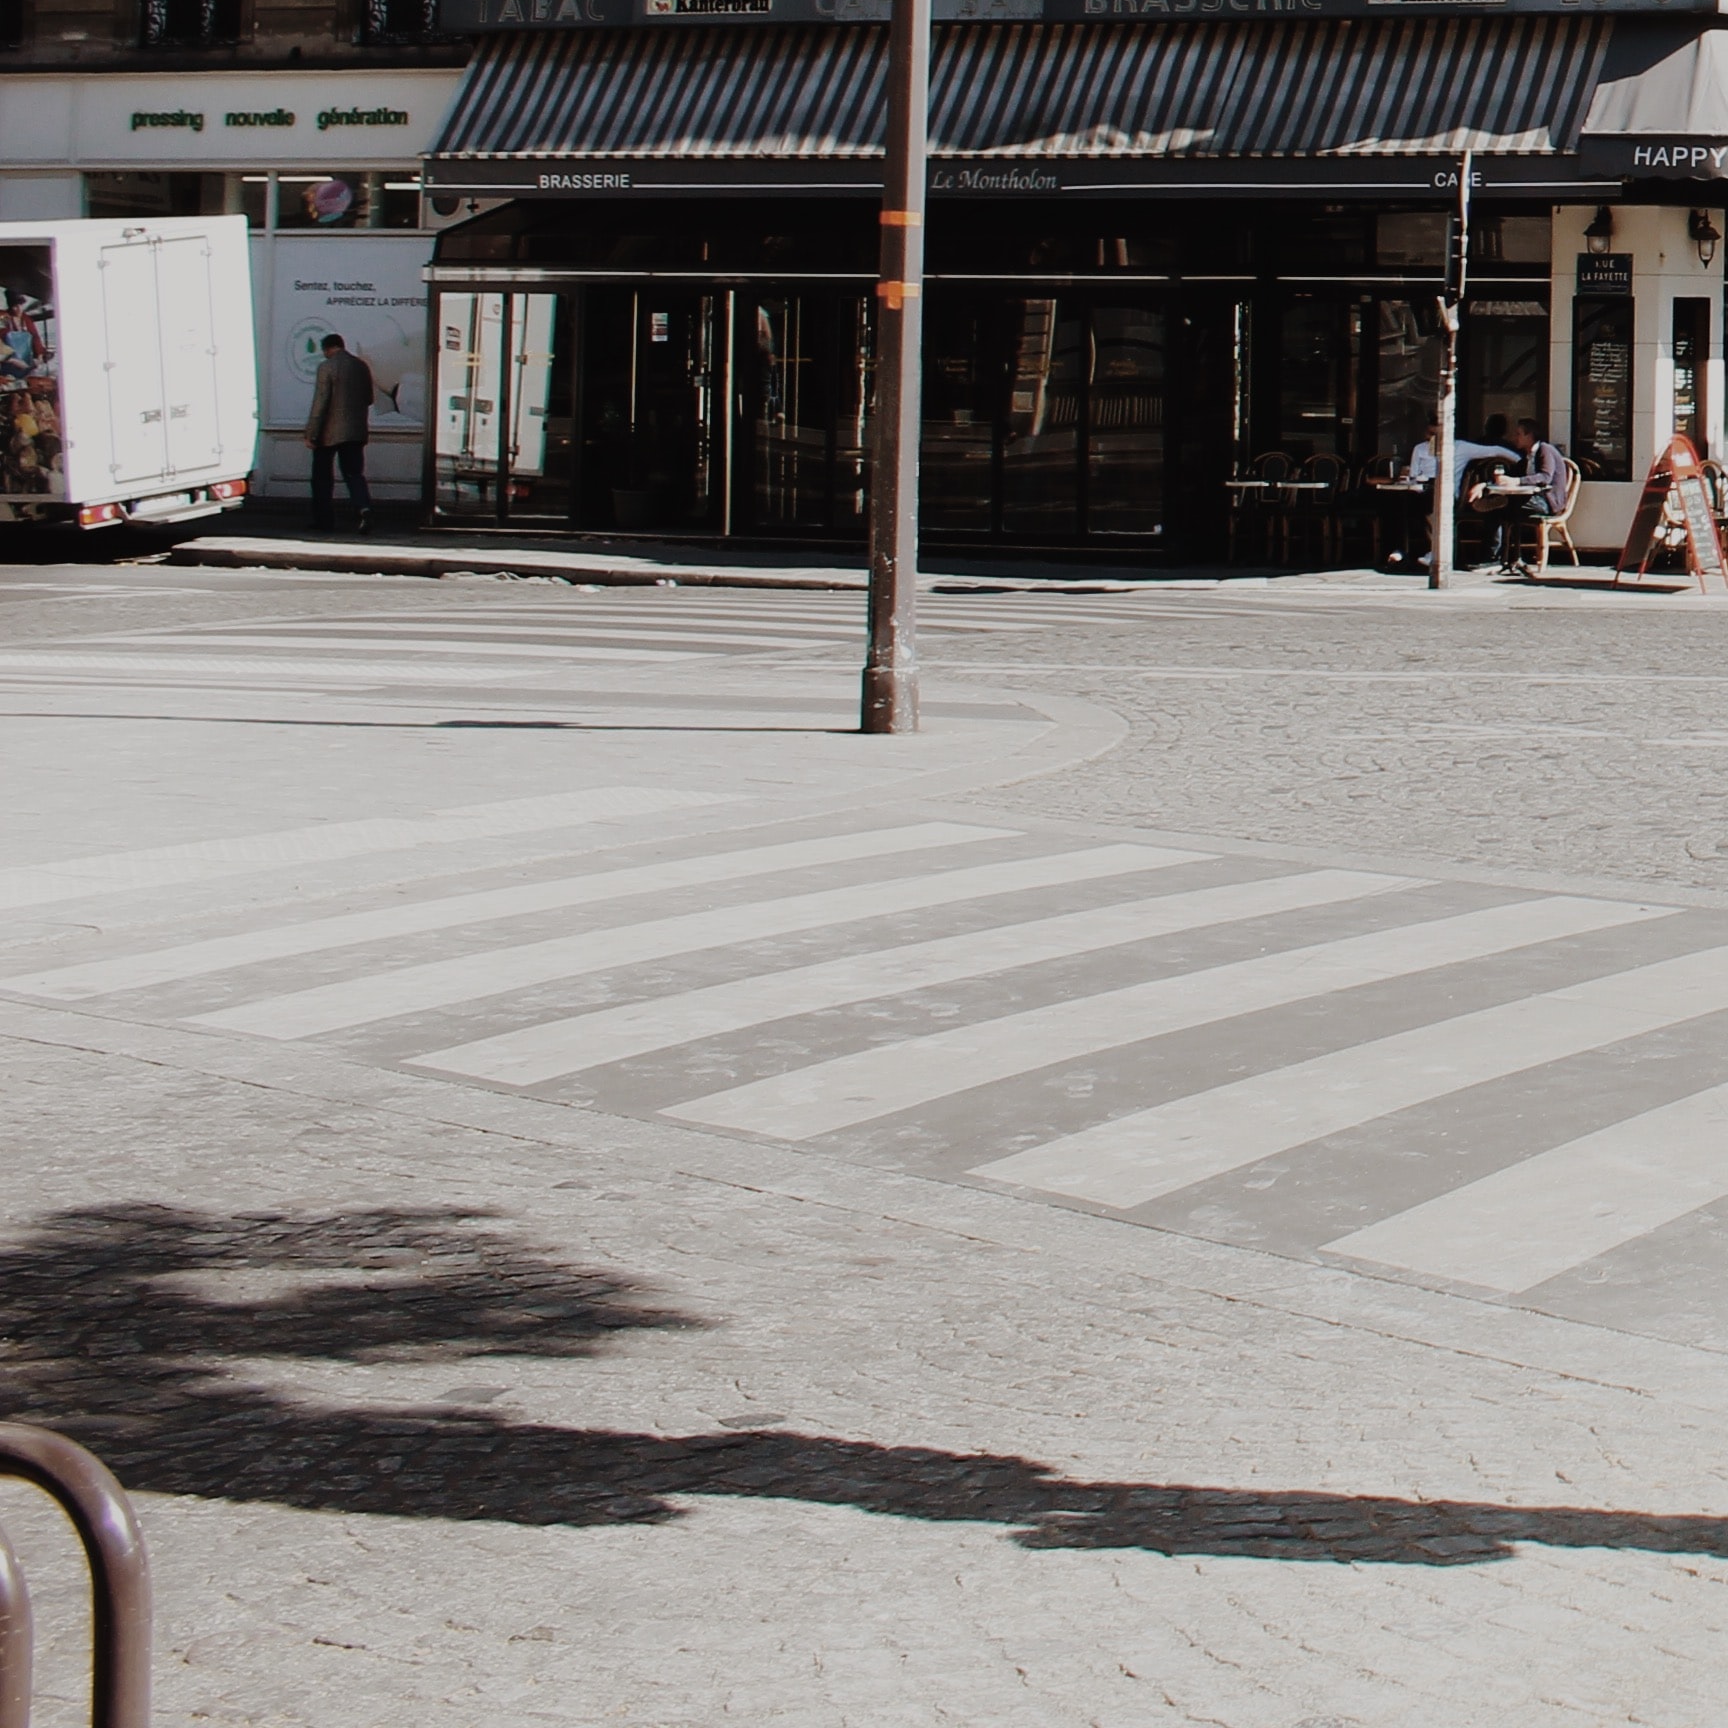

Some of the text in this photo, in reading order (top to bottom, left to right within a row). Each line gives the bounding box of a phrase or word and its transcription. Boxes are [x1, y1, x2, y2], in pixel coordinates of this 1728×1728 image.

[131, 107, 408, 131] pressing nouvelle génération
[1634, 145, 1728, 168] HAPPY
[539, 174, 630, 189] BRASSERIE
[931, 168, 1057, 191] Le Montholon
[1434, 172, 1482, 187] CAE
[1581, 271, 1628, 282] LA FAYETTE
[294, 280, 331, 292] Sentez,
[378, 296, 389, 306] LA
